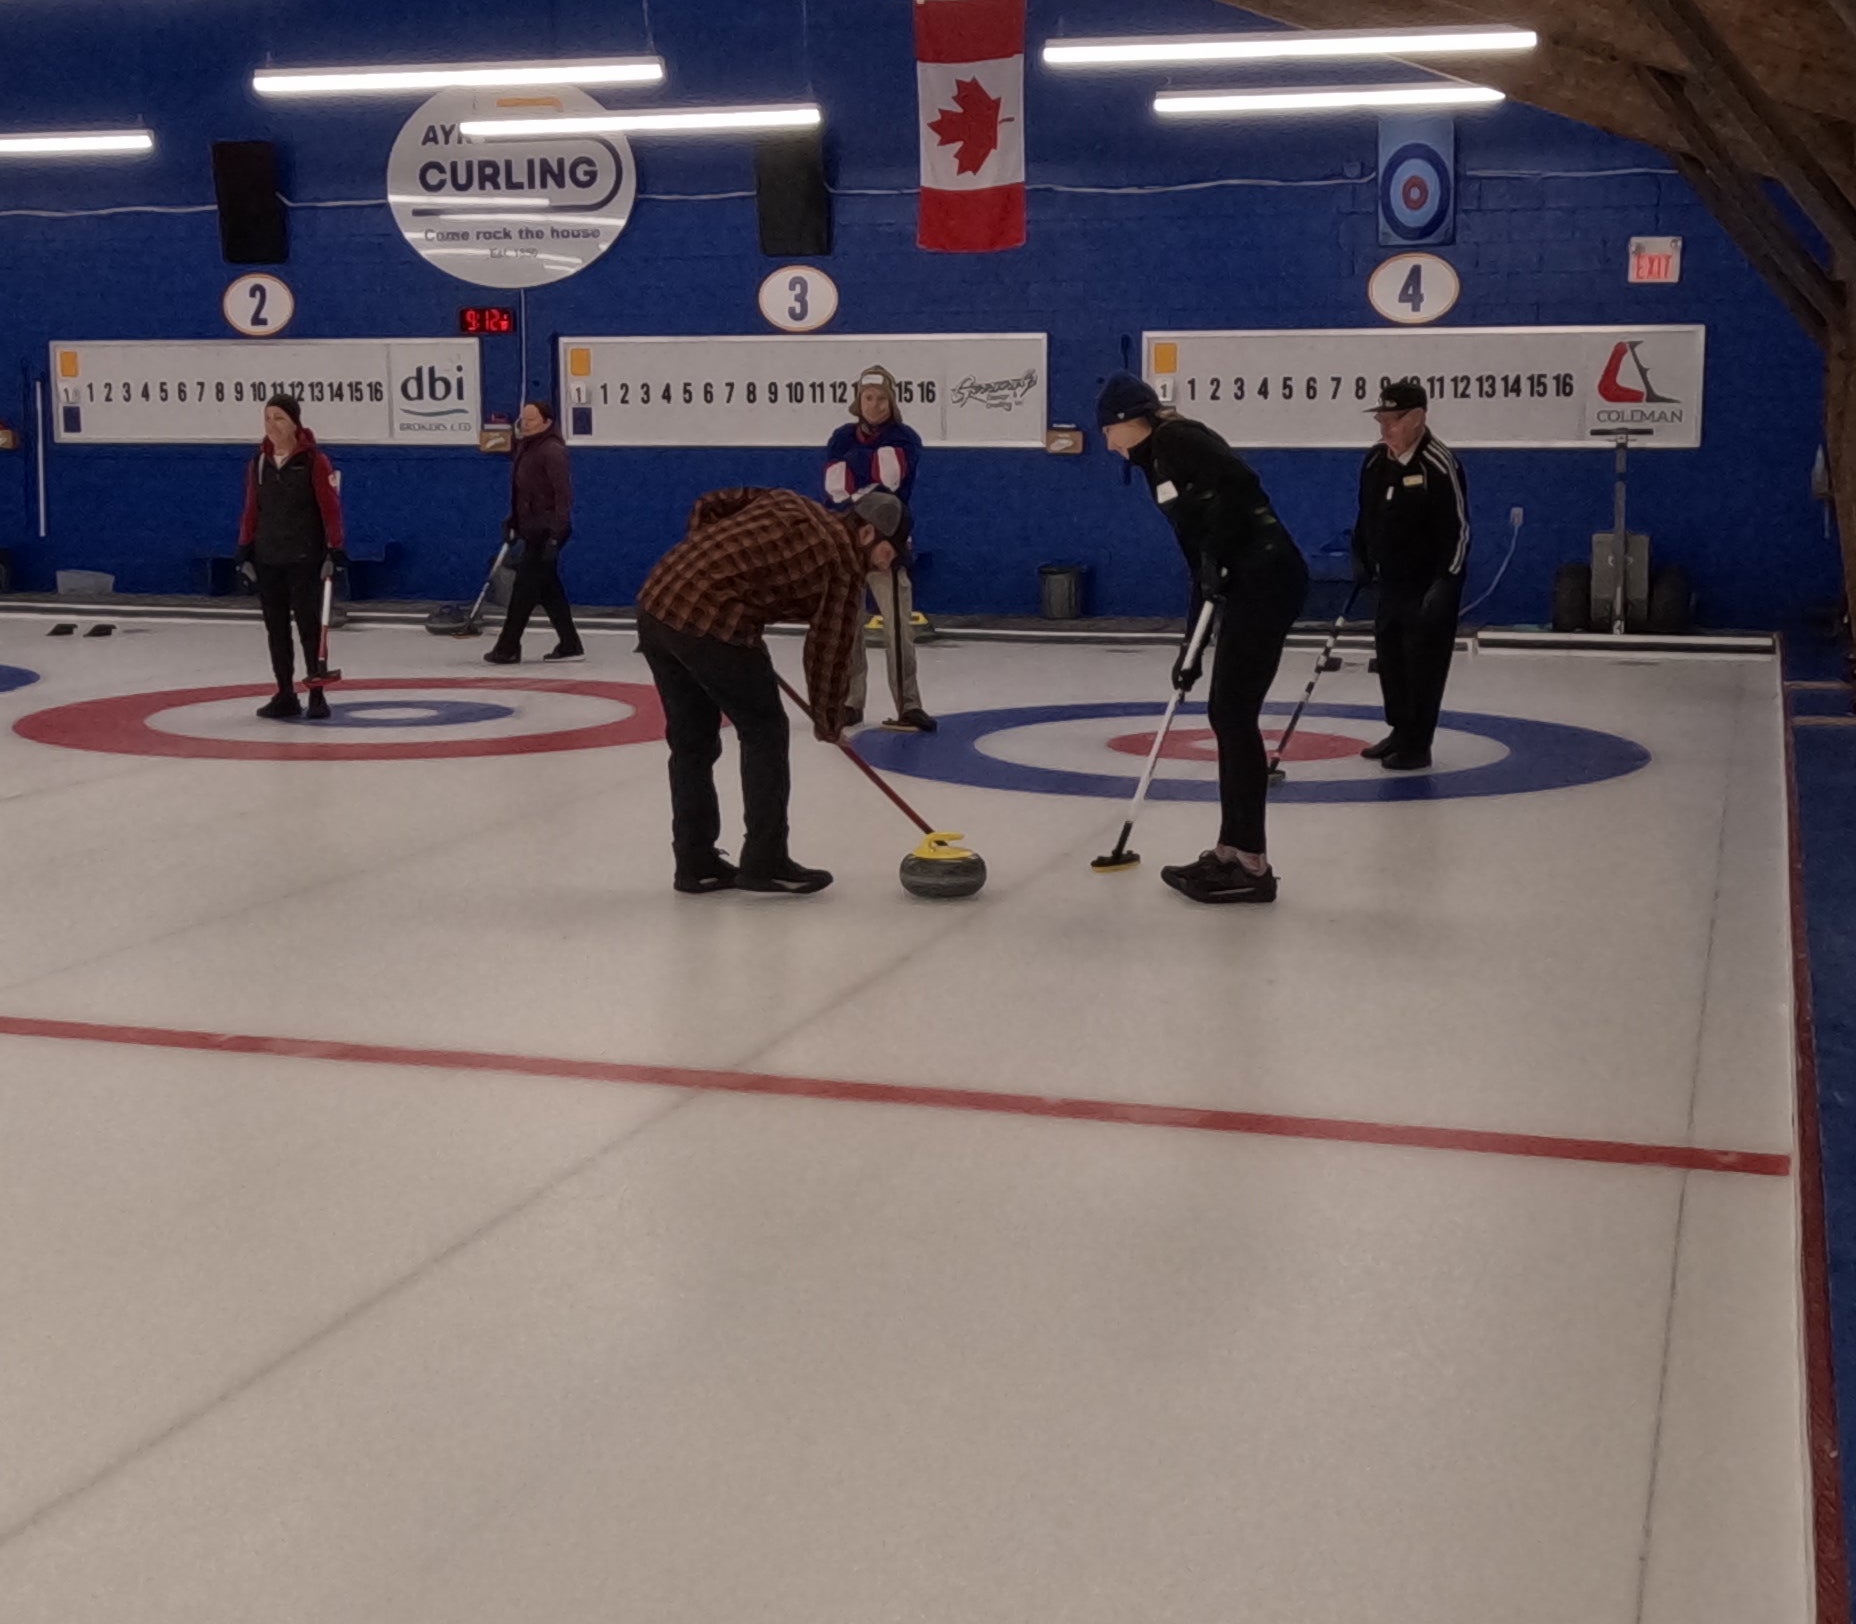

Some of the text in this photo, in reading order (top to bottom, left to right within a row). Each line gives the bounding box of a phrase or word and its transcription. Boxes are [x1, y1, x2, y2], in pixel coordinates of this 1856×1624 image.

[418, 156, 598, 193] CURLING
[424, 226, 601, 242] Come rock the house
[1635, 253, 1672, 280] EXIT
[249, 283, 268, 326] 2
[787, 276, 809, 322] 3
[1397, 263, 1425, 313] 4
[86, 382, 95, 403] 1
[103, 382, 113, 403] 2
[122, 381, 132, 403] 3
[141, 381, 150, 402] 4
[159, 381, 169, 402] 5
[177, 381, 187, 403] 6
[196, 381, 205, 402] 7
[215, 381, 225, 403] 8
[234, 381, 244, 402] 9
[249, 381, 267, 403] 10
[288, 381, 305, 402] 12
[307, 381, 325, 402] 13
[327, 381, 345, 402] 14
[346, 381, 364, 402] 15
[366, 381, 384, 402] 16
[400, 364, 465, 402] dbi
[599, 382, 609, 405] 1
[619, 382, 630, 405] 2
[640, 382, 651, 405] 3
[661, 382, 672, 404] 4
[682, 381, 693, 404] 5
[703, 381, 714, 404] 6
[724, 381, 735, 404] 7
[746, 381, 757, 404] 8
[767, 381, 779, 404] 9
[785, 381, 805, 404] 10
[808, 381, 825, 404] 11
[829, 380, 848, 404] 12
[894, 380, 914, 404] 15
[917, 380, 936, 404] 16
[1187, 377, 1196, 401] 1
[1209, 377, 1221, 401] 2
[1233, 376, 1245, 401] 3
[1257, 376, 1270, 400] 4
[1281, 376, 1294, 400] 5
[1305, 376, 1318, 400] 6
[1330, 376, 1342, 400] 7
[1354, 376, 1367, 401] 8
[1426, 375, 1445, 399] 11
[1450, 374, 1471, 399] 12
[1475, 374, 1497, 399] 13
[1500, 373, 1523, 398] 14
[1526, 373, 1548, 398] 15
[1552, 372, 1574, 398] 16
